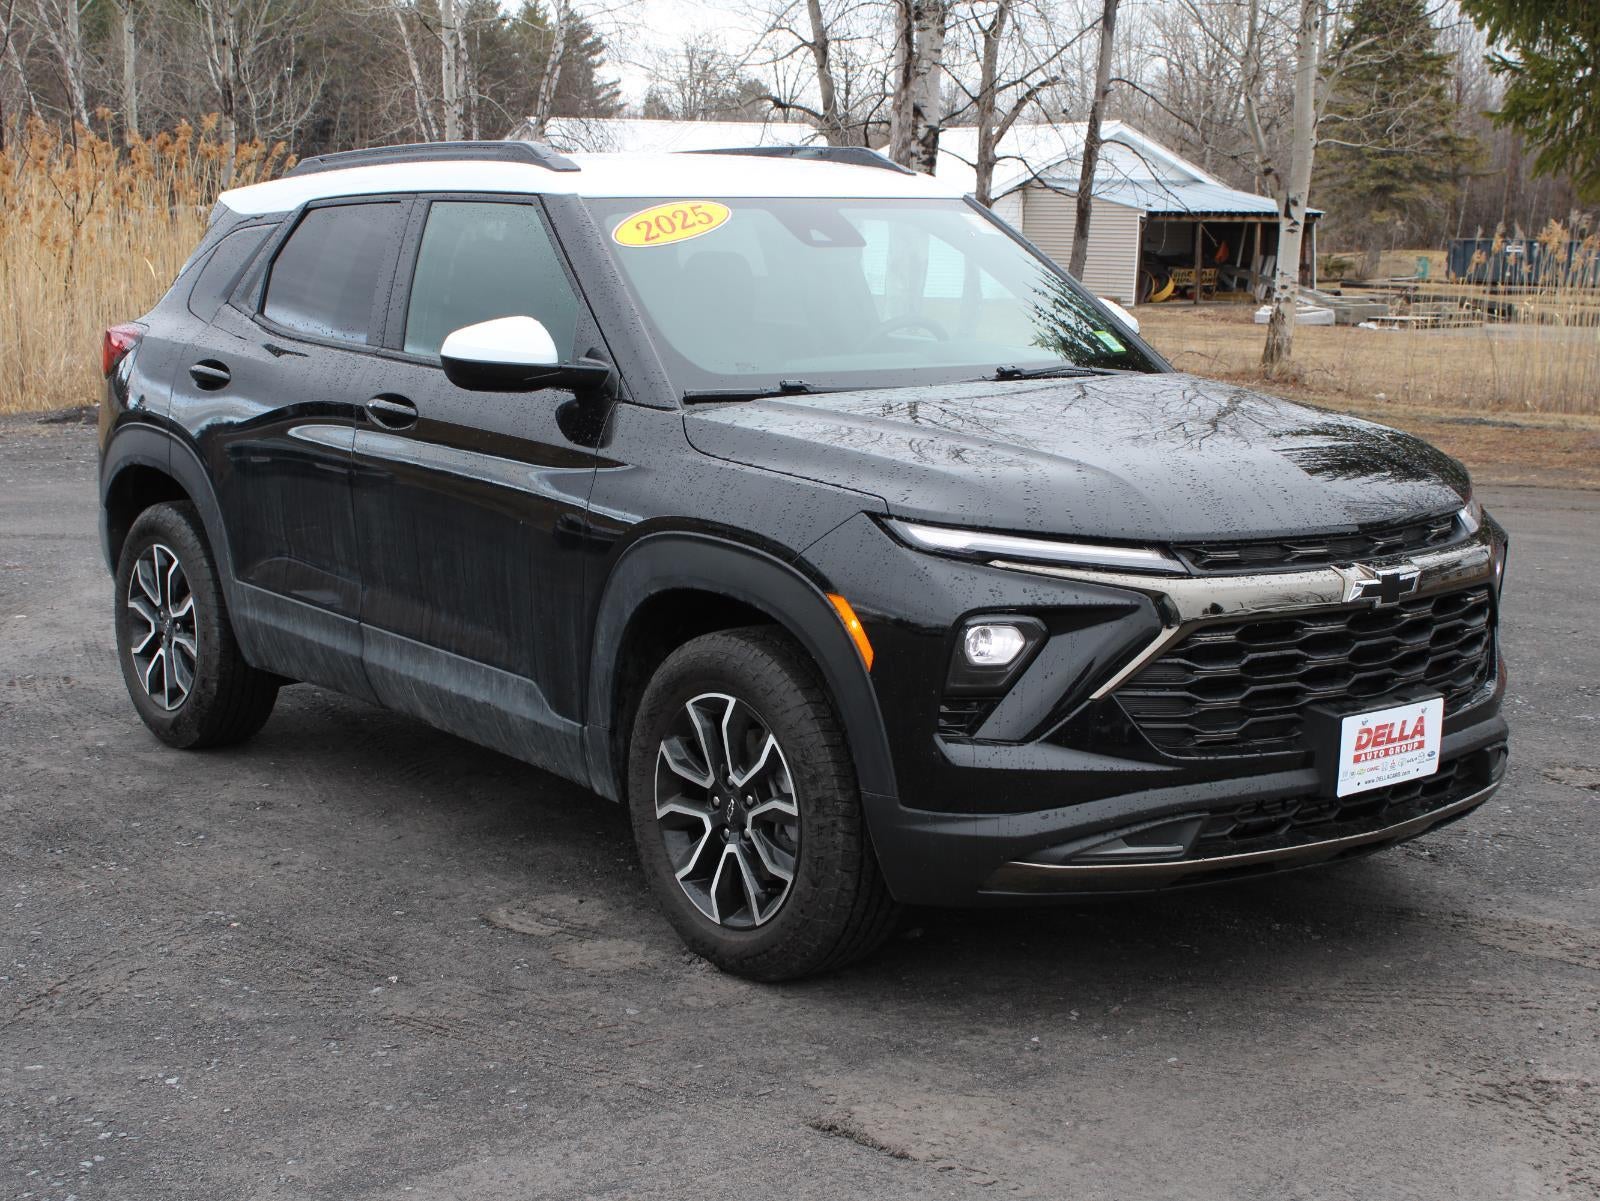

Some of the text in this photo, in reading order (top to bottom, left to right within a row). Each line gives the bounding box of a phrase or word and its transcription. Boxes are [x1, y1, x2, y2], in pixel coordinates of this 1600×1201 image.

[636, 205, 714, 242] 2025
[1354, 715, 1425, 752] DELLA
[1360, 742, 1419, 762] AUTO GROUP
